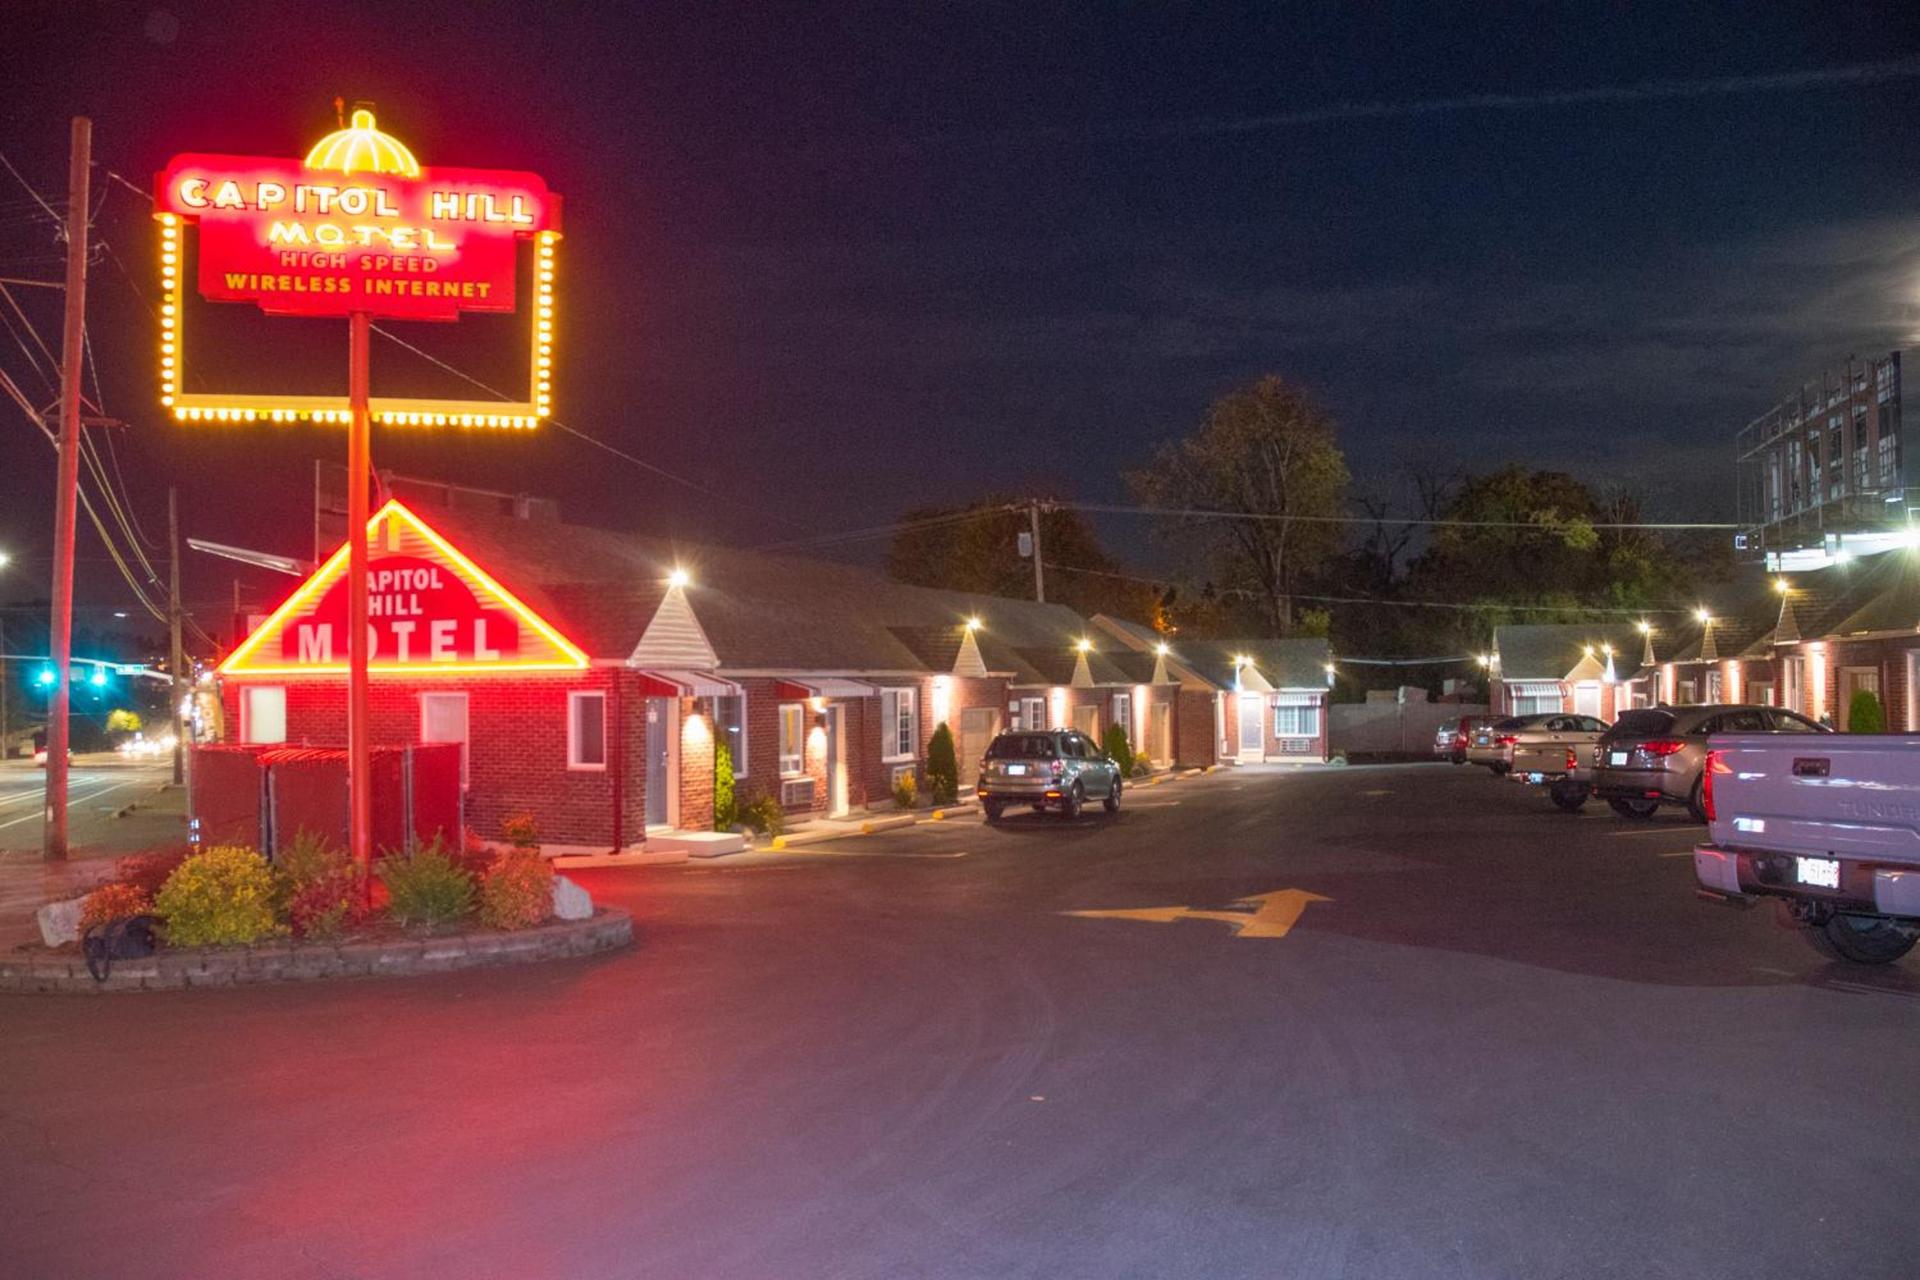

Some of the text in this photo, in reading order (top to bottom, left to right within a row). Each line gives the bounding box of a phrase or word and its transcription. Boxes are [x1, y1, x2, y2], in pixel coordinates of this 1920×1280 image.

[180, 178, 534, 224] CAPITOL HILL
[268, 220, 457, 250] MOTEL
[280, 251, 439, 272] HIGH SPEED
[225, 273, 491, 298] WIRELESS INTERNET
[366, 567, 444, 592] APITOL
[368, 593, 423, 616] HILL
